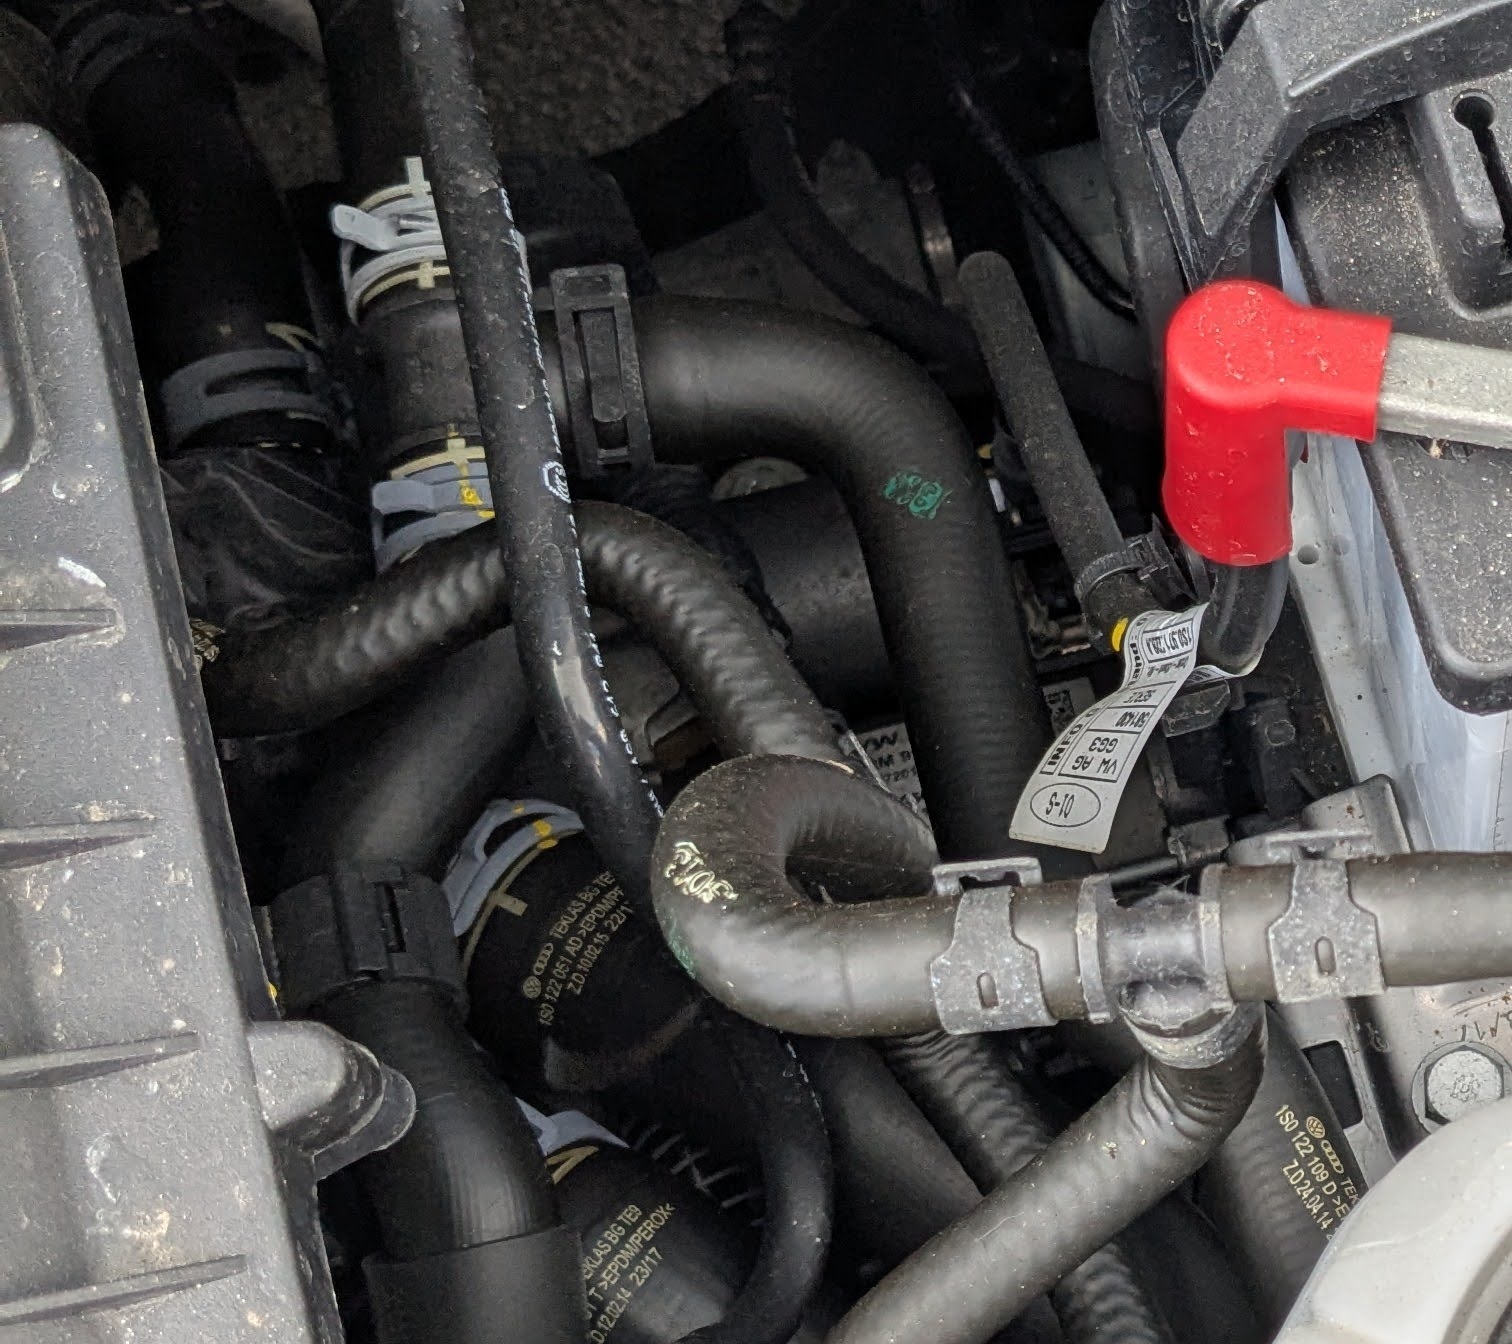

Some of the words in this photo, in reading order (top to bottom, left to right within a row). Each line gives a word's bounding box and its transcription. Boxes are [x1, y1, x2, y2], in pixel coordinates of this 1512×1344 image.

[1274, 1104, 1300, 1132] 1S0
[1289, 1130, 1313, 1157] 122
[1305, 1156, 1329, 1183] 109
[1320, 1181, 1337, 1197] D
[1329, 1194, 1350, 1220] >E
[1283, 1159, 1332, 1230] Z.D.24.04.14
[1341, 1178, 1360, 1205] TEK
[582, 1238, 612, 1280] EKLAS
[602, 1221, 626, 1244] BG
[616, 1202, 643, 1226] TE9
[600, 1203, 675, 1291] >EPDM/PEROX<
[628, 1245, 662, 1286] 23/17
